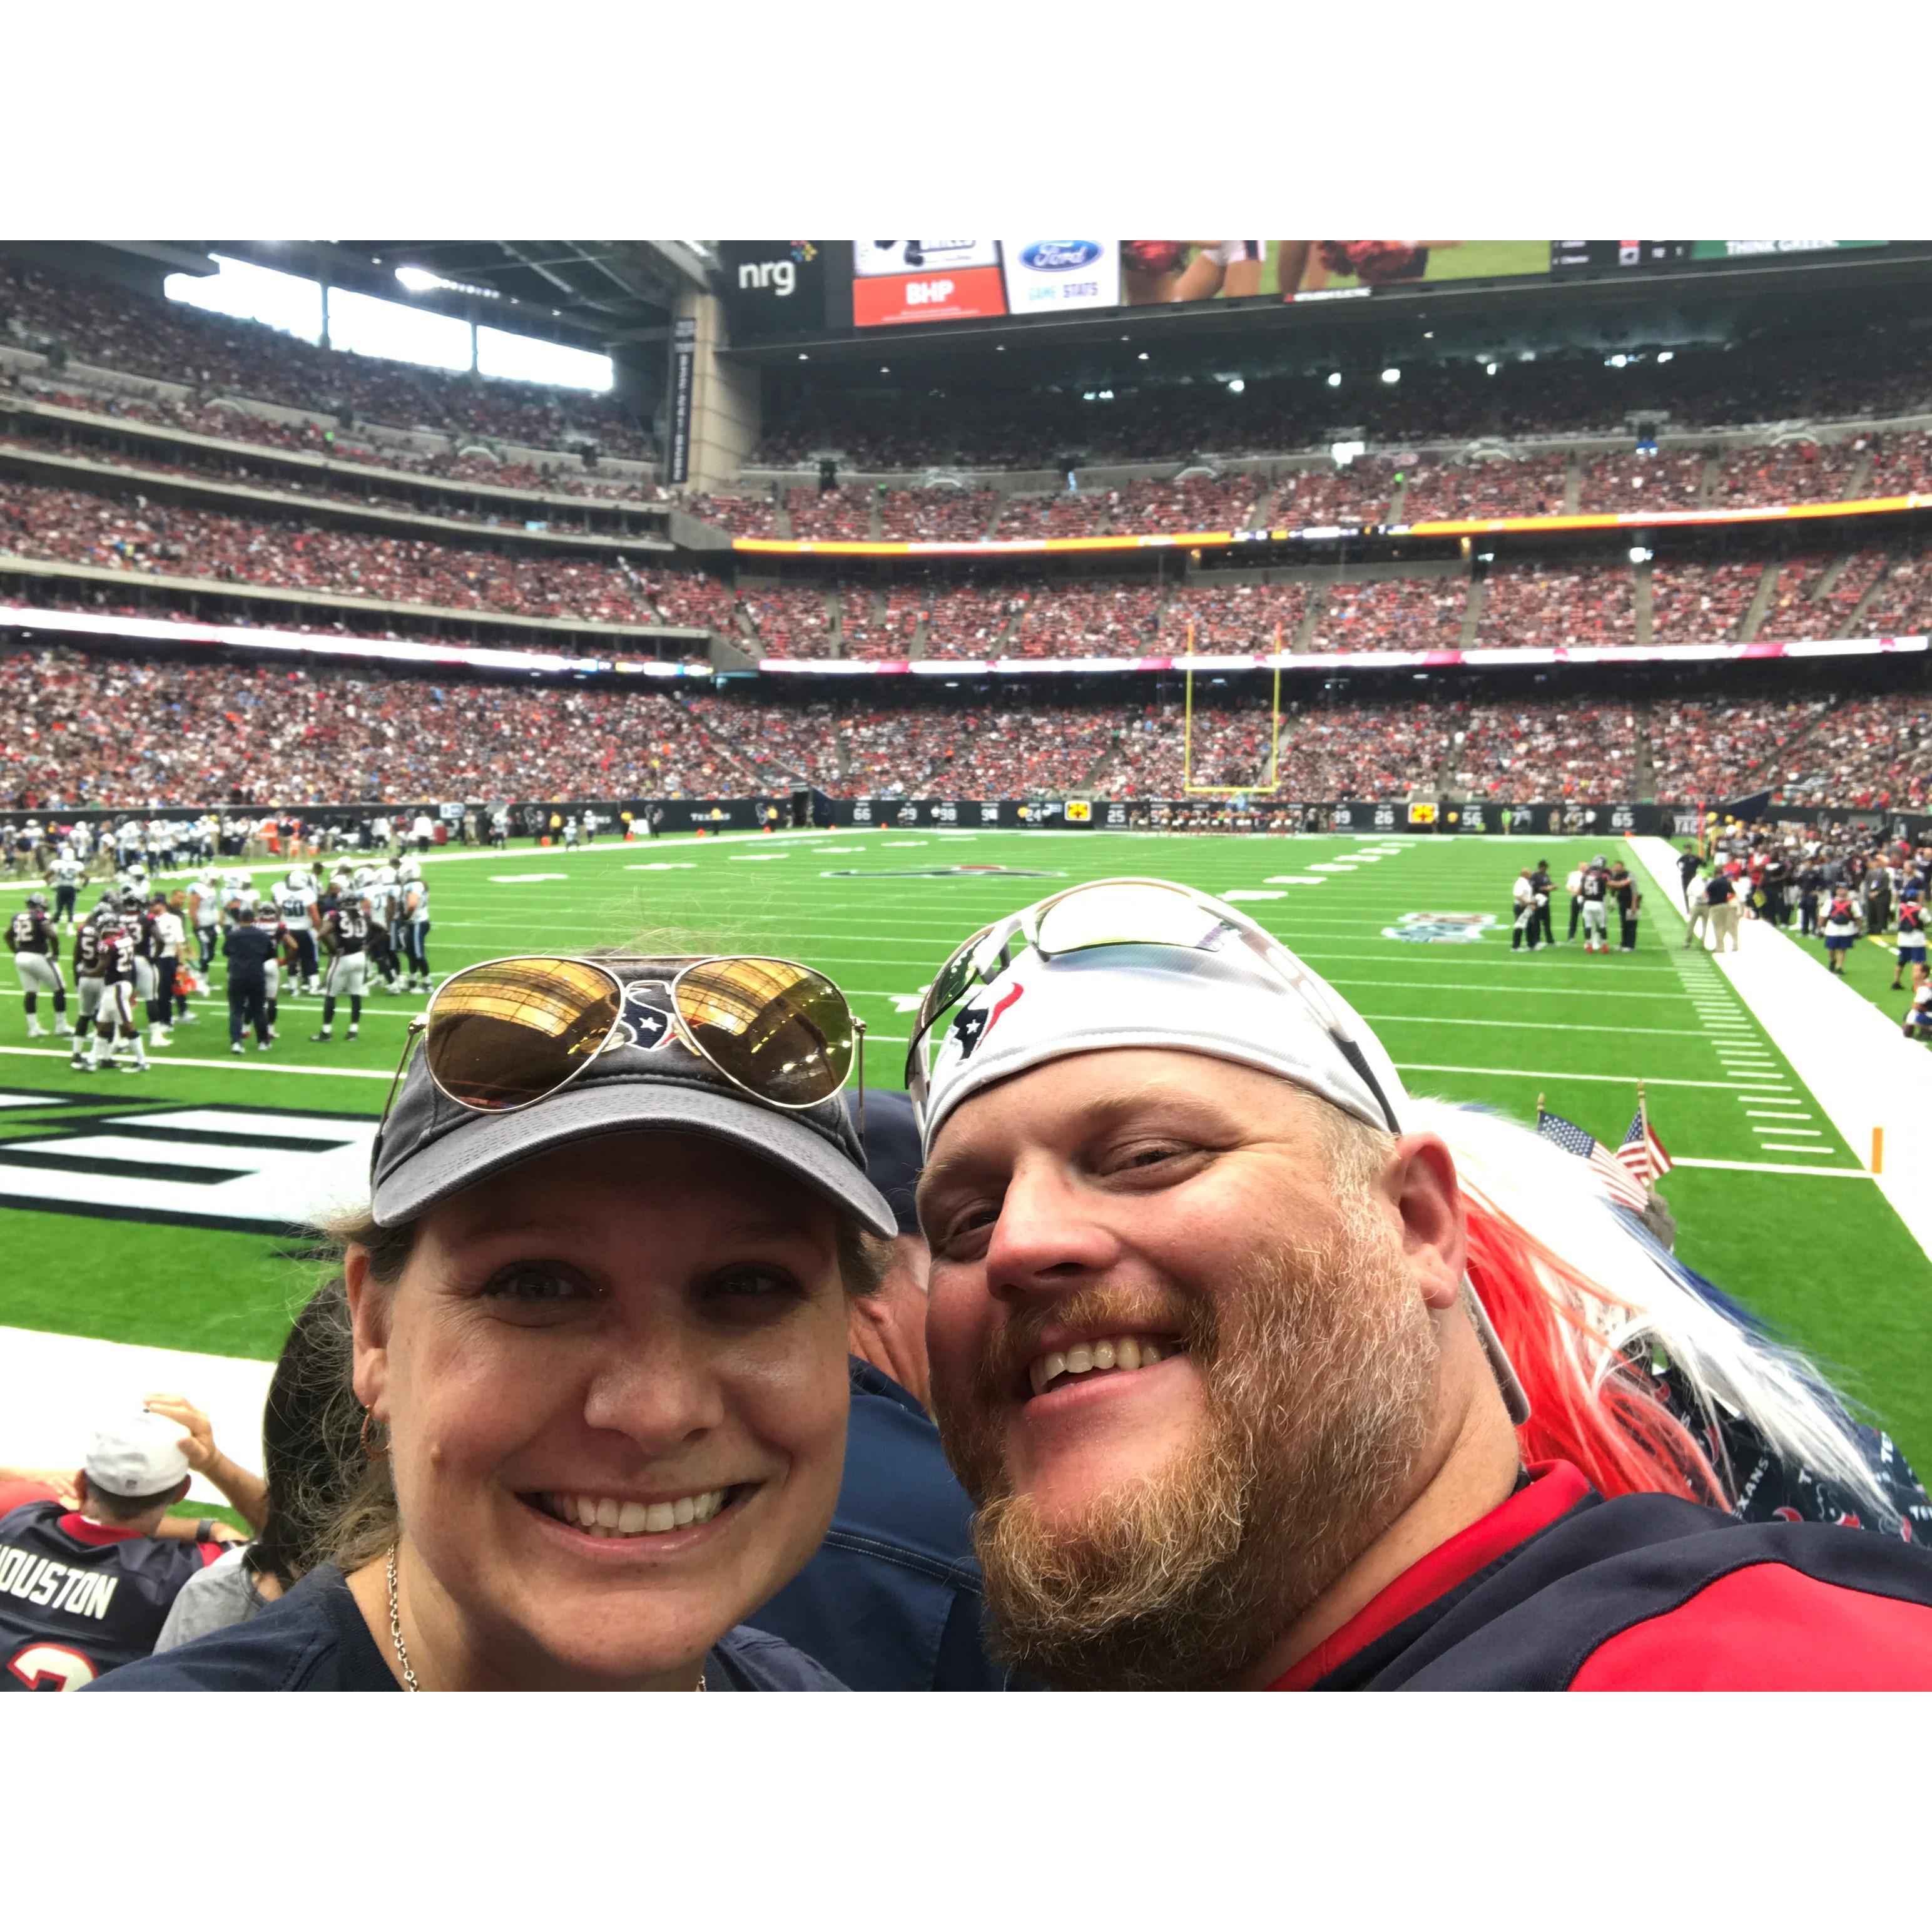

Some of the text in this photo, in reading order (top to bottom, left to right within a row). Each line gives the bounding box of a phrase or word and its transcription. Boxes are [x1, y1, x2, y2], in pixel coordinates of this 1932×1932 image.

[1034, 246, 1087, 267] Ford
[739, 260, 795, 296] nrg
[905, 279, 954, 305] BHP
[1063, 282, 1099, 298] STATS
